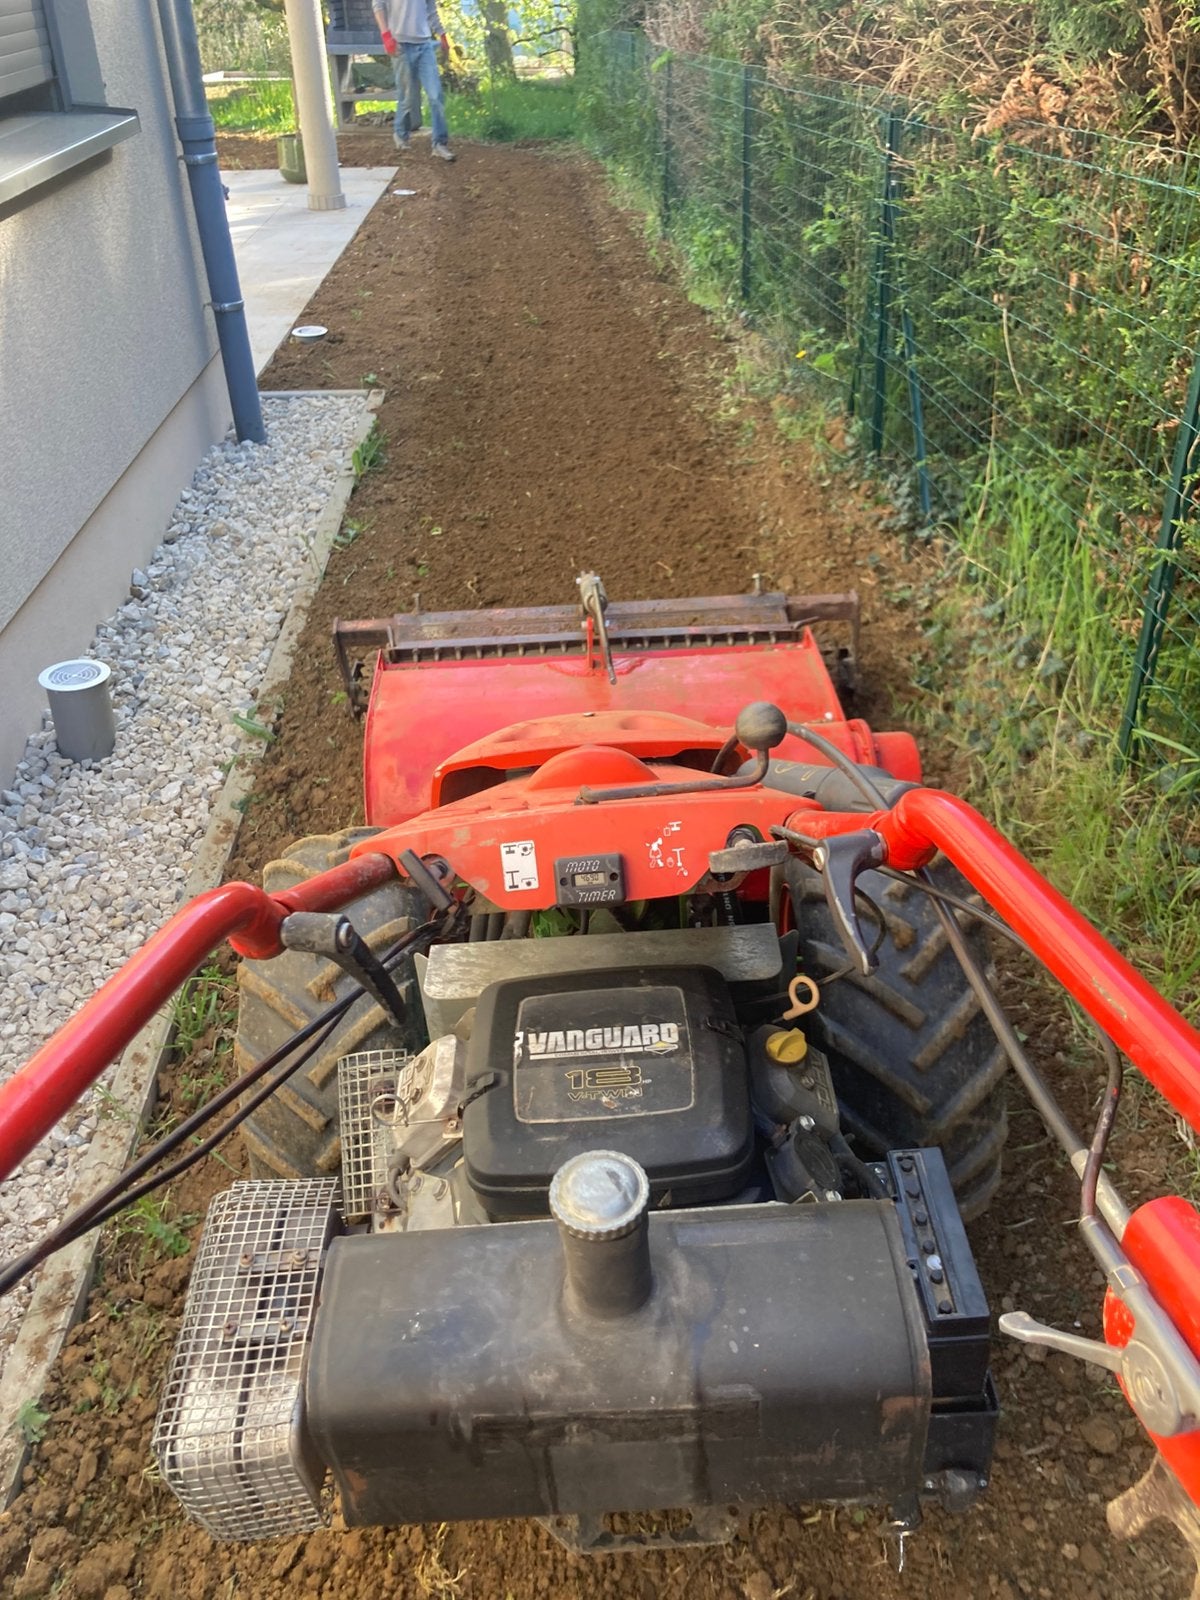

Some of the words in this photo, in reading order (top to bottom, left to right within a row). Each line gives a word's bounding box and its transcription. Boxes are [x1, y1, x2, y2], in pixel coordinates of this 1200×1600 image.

[566, 860, 600, 872] MOTO
[579, 889, 616, 902] TIMER
[528, 1023, 679, 1053] VANGUARD
[565, 1066, 642, 1089] 18
